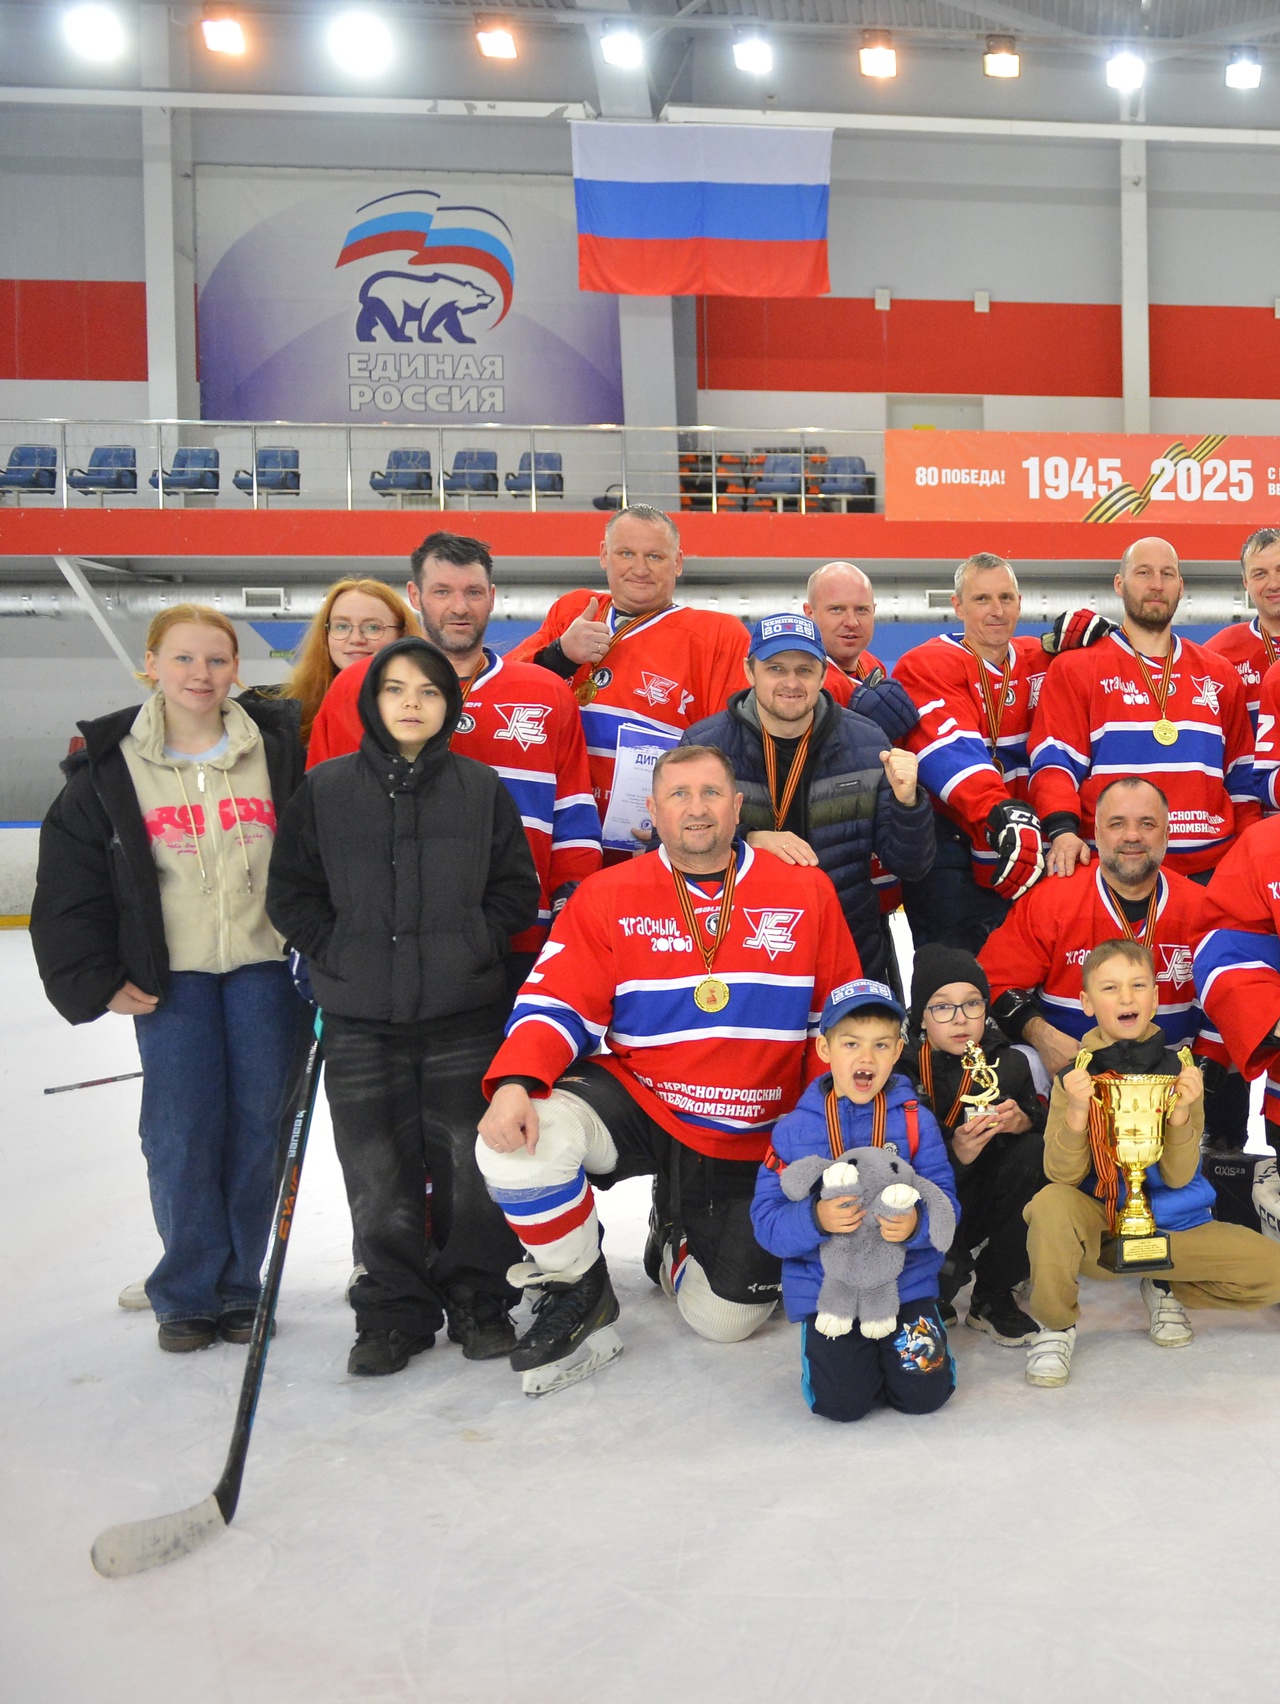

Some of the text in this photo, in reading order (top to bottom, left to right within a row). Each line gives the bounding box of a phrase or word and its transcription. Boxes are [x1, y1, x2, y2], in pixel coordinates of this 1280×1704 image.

[348, 352, 505, 382] ЕДИНАЯ
[349, 383, 505, 413] РОССИЯ
[915, 466, 1006, 487] 80 ПОБЕДА!
[1021, 456, 1254, 502] 1945 2025
[1267, 467, 1275, 480] С
[635, 753, 659, 767] ДИП
[1009, 809, 1041, 830] CC
[656, 1081, 783, 1103] «КРАСНОГОРОДСКИЙ
